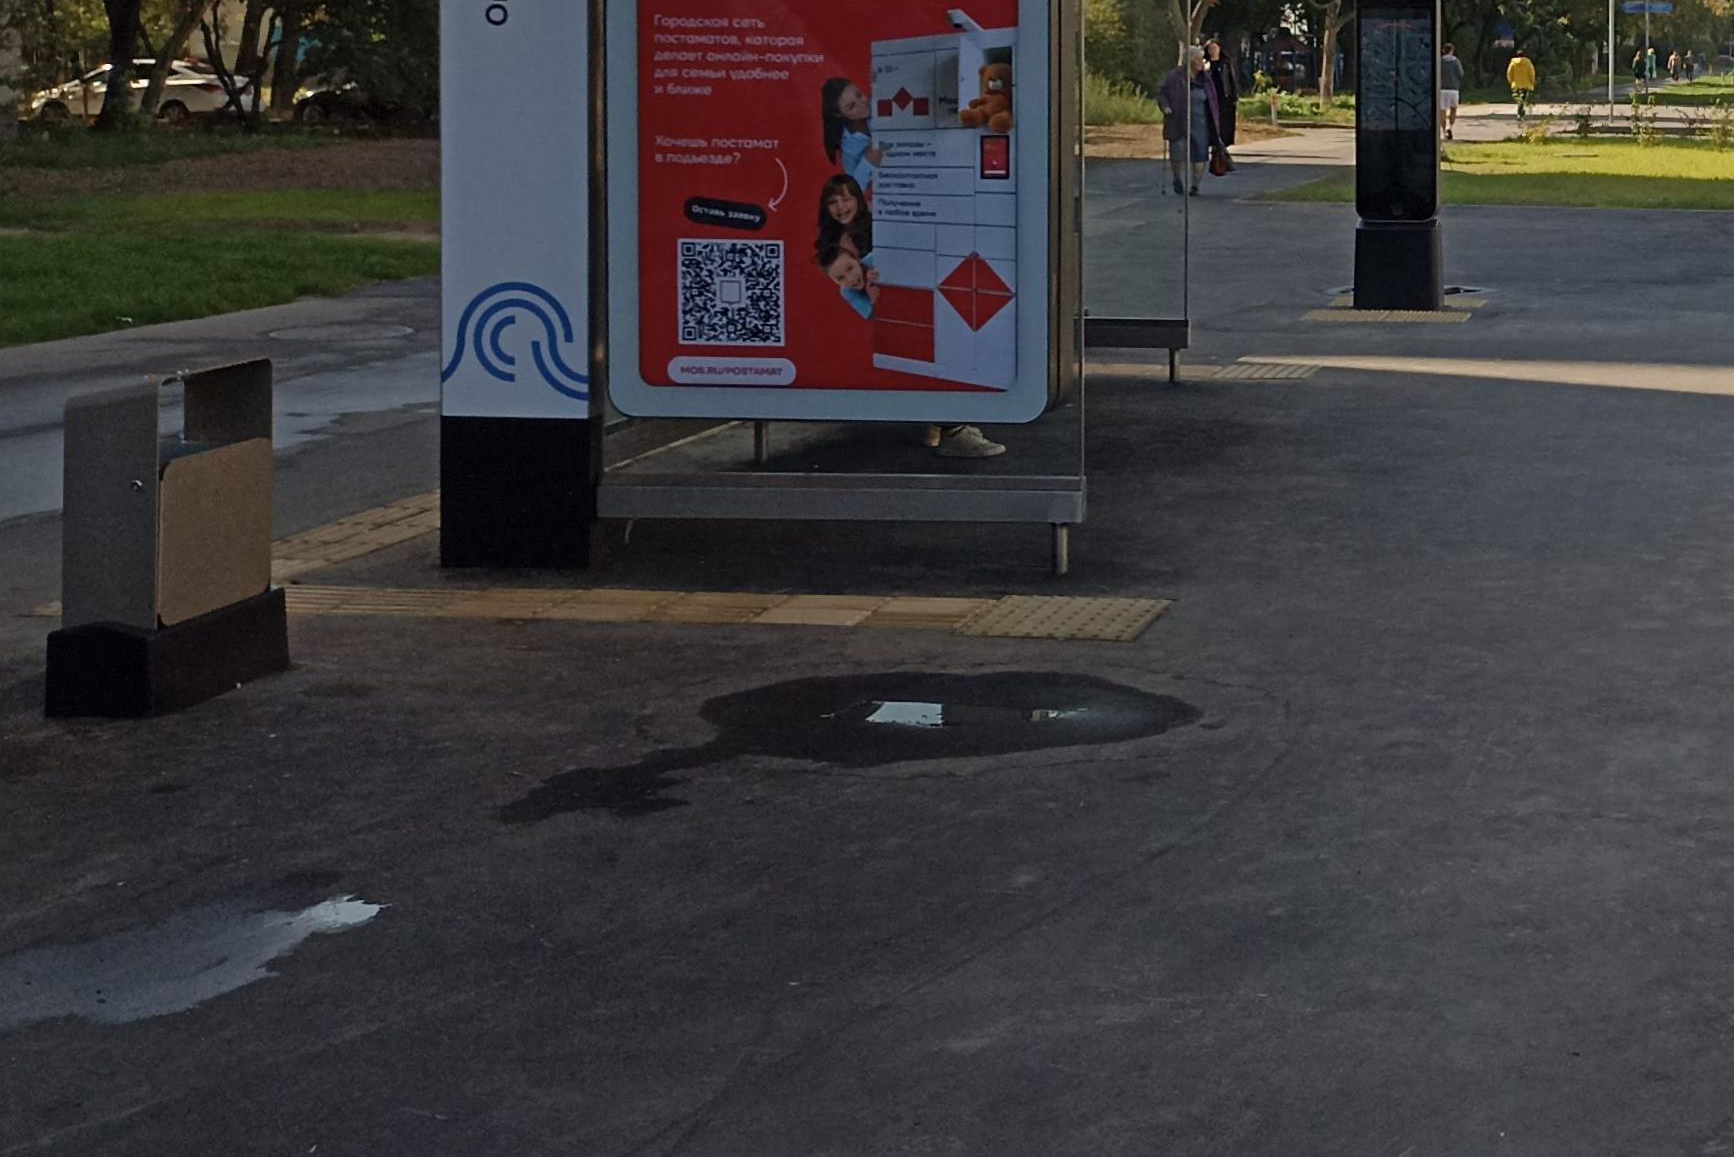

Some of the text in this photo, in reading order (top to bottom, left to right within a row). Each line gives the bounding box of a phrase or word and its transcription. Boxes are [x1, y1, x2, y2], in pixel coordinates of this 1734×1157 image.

[654, 14, 766, 28] Городская сеть
[654, 34, 804, 48] постаматов, которая
[654, 68, 679, 79] для
[730, 68, 790, 80] удобнее
[666, 83, 712, 96] ближе
[711, 138, 779, 149] постамат
[654, 154, 664, 163] в
